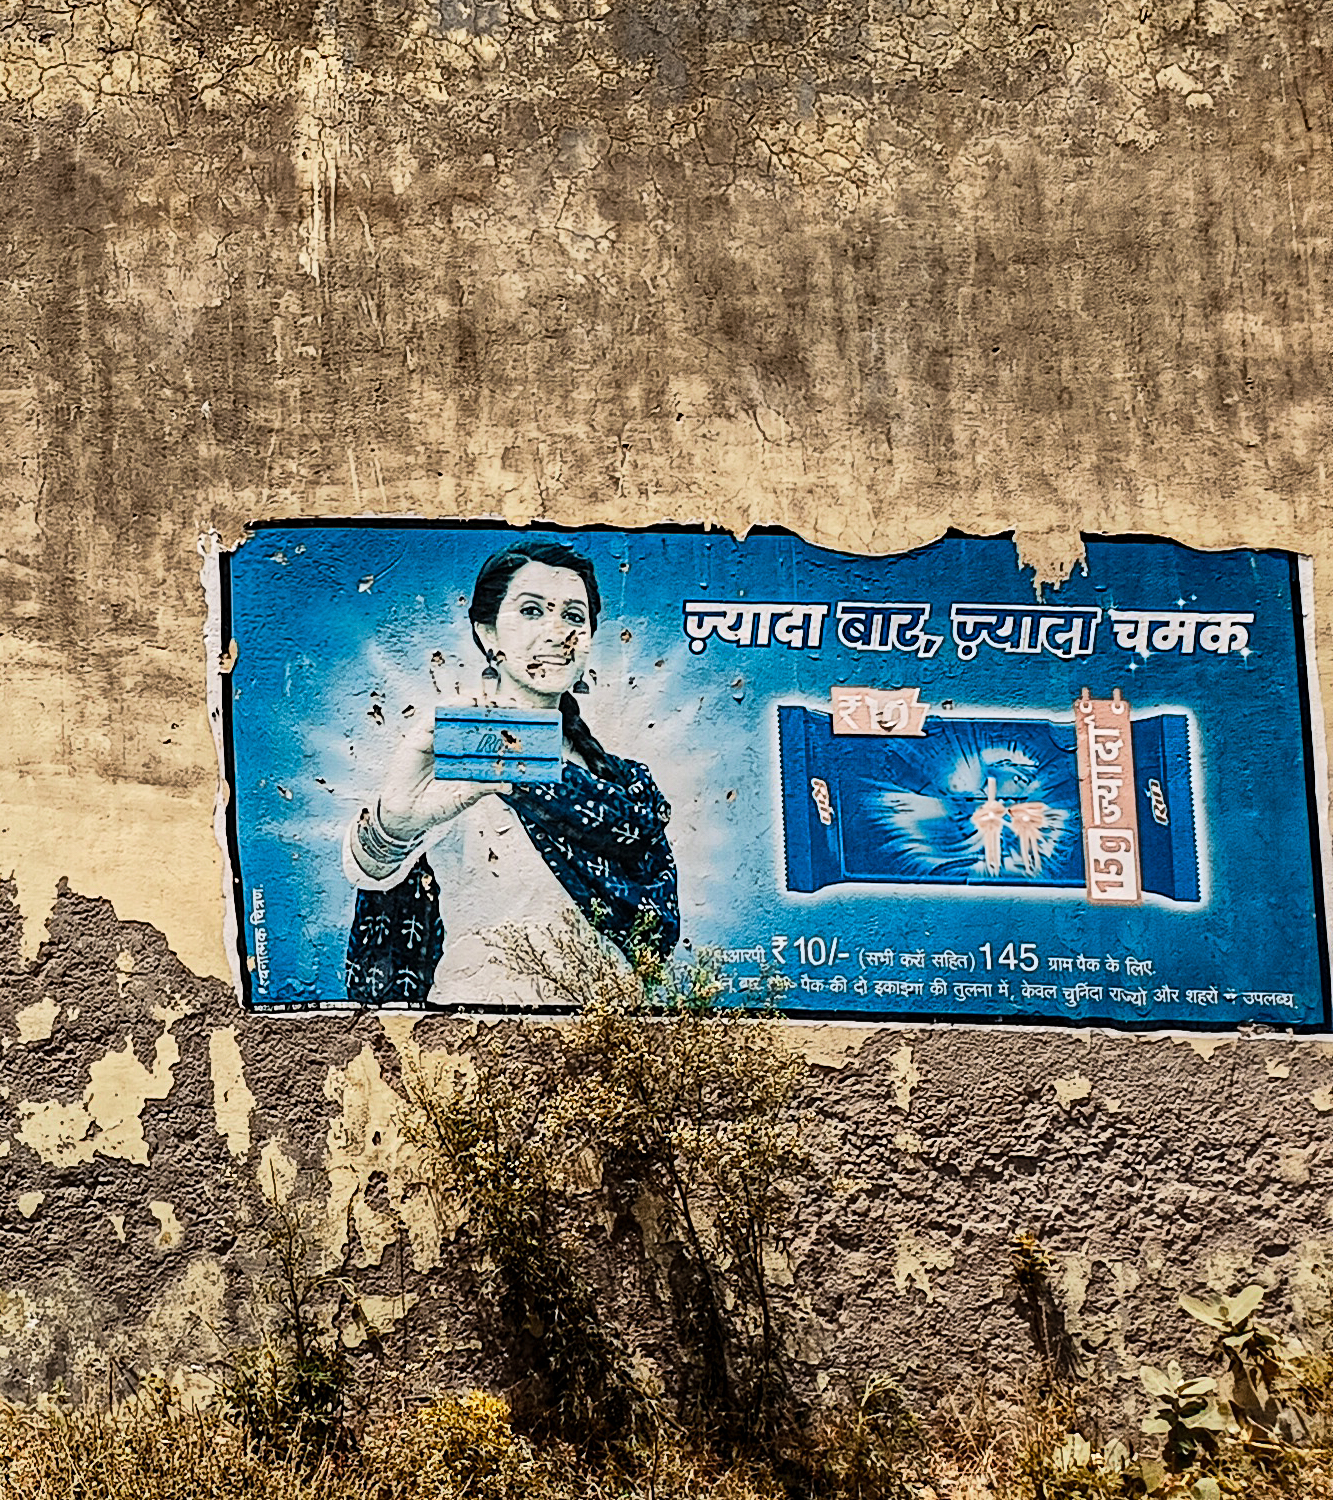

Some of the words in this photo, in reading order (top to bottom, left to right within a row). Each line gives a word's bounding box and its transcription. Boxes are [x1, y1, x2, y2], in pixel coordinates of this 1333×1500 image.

[683, 600, 831, 656] ज़्यादा
[836, 601, 944, 658] बार,
[950, 603, 1102, 660] ज़्यादा
[1109, 610, 1255, 654] चमक
[859, 948, 896, 970] (सभी
[931, 949, 976, 973] सहित)
[979, 941, 1040, 972] 145
[1047, 956, 1074, 973] ग्राम
[1076, 952, 1101, 973] पैक
[1104, 954, 1120, 973] के
[828, 975, 848, 993] की
[853, 975, 868, 996] दो
[929, 977, 947, 996] की
[953, 982, 992, 1002] तुलना
[1021, 979, 1057, 999] केवल
[1062, 981, 1103, 1008] चुनिंदा
[1153, 984, 1180, 1003] और
[1185, 985, 1219, 1006] शहरों
